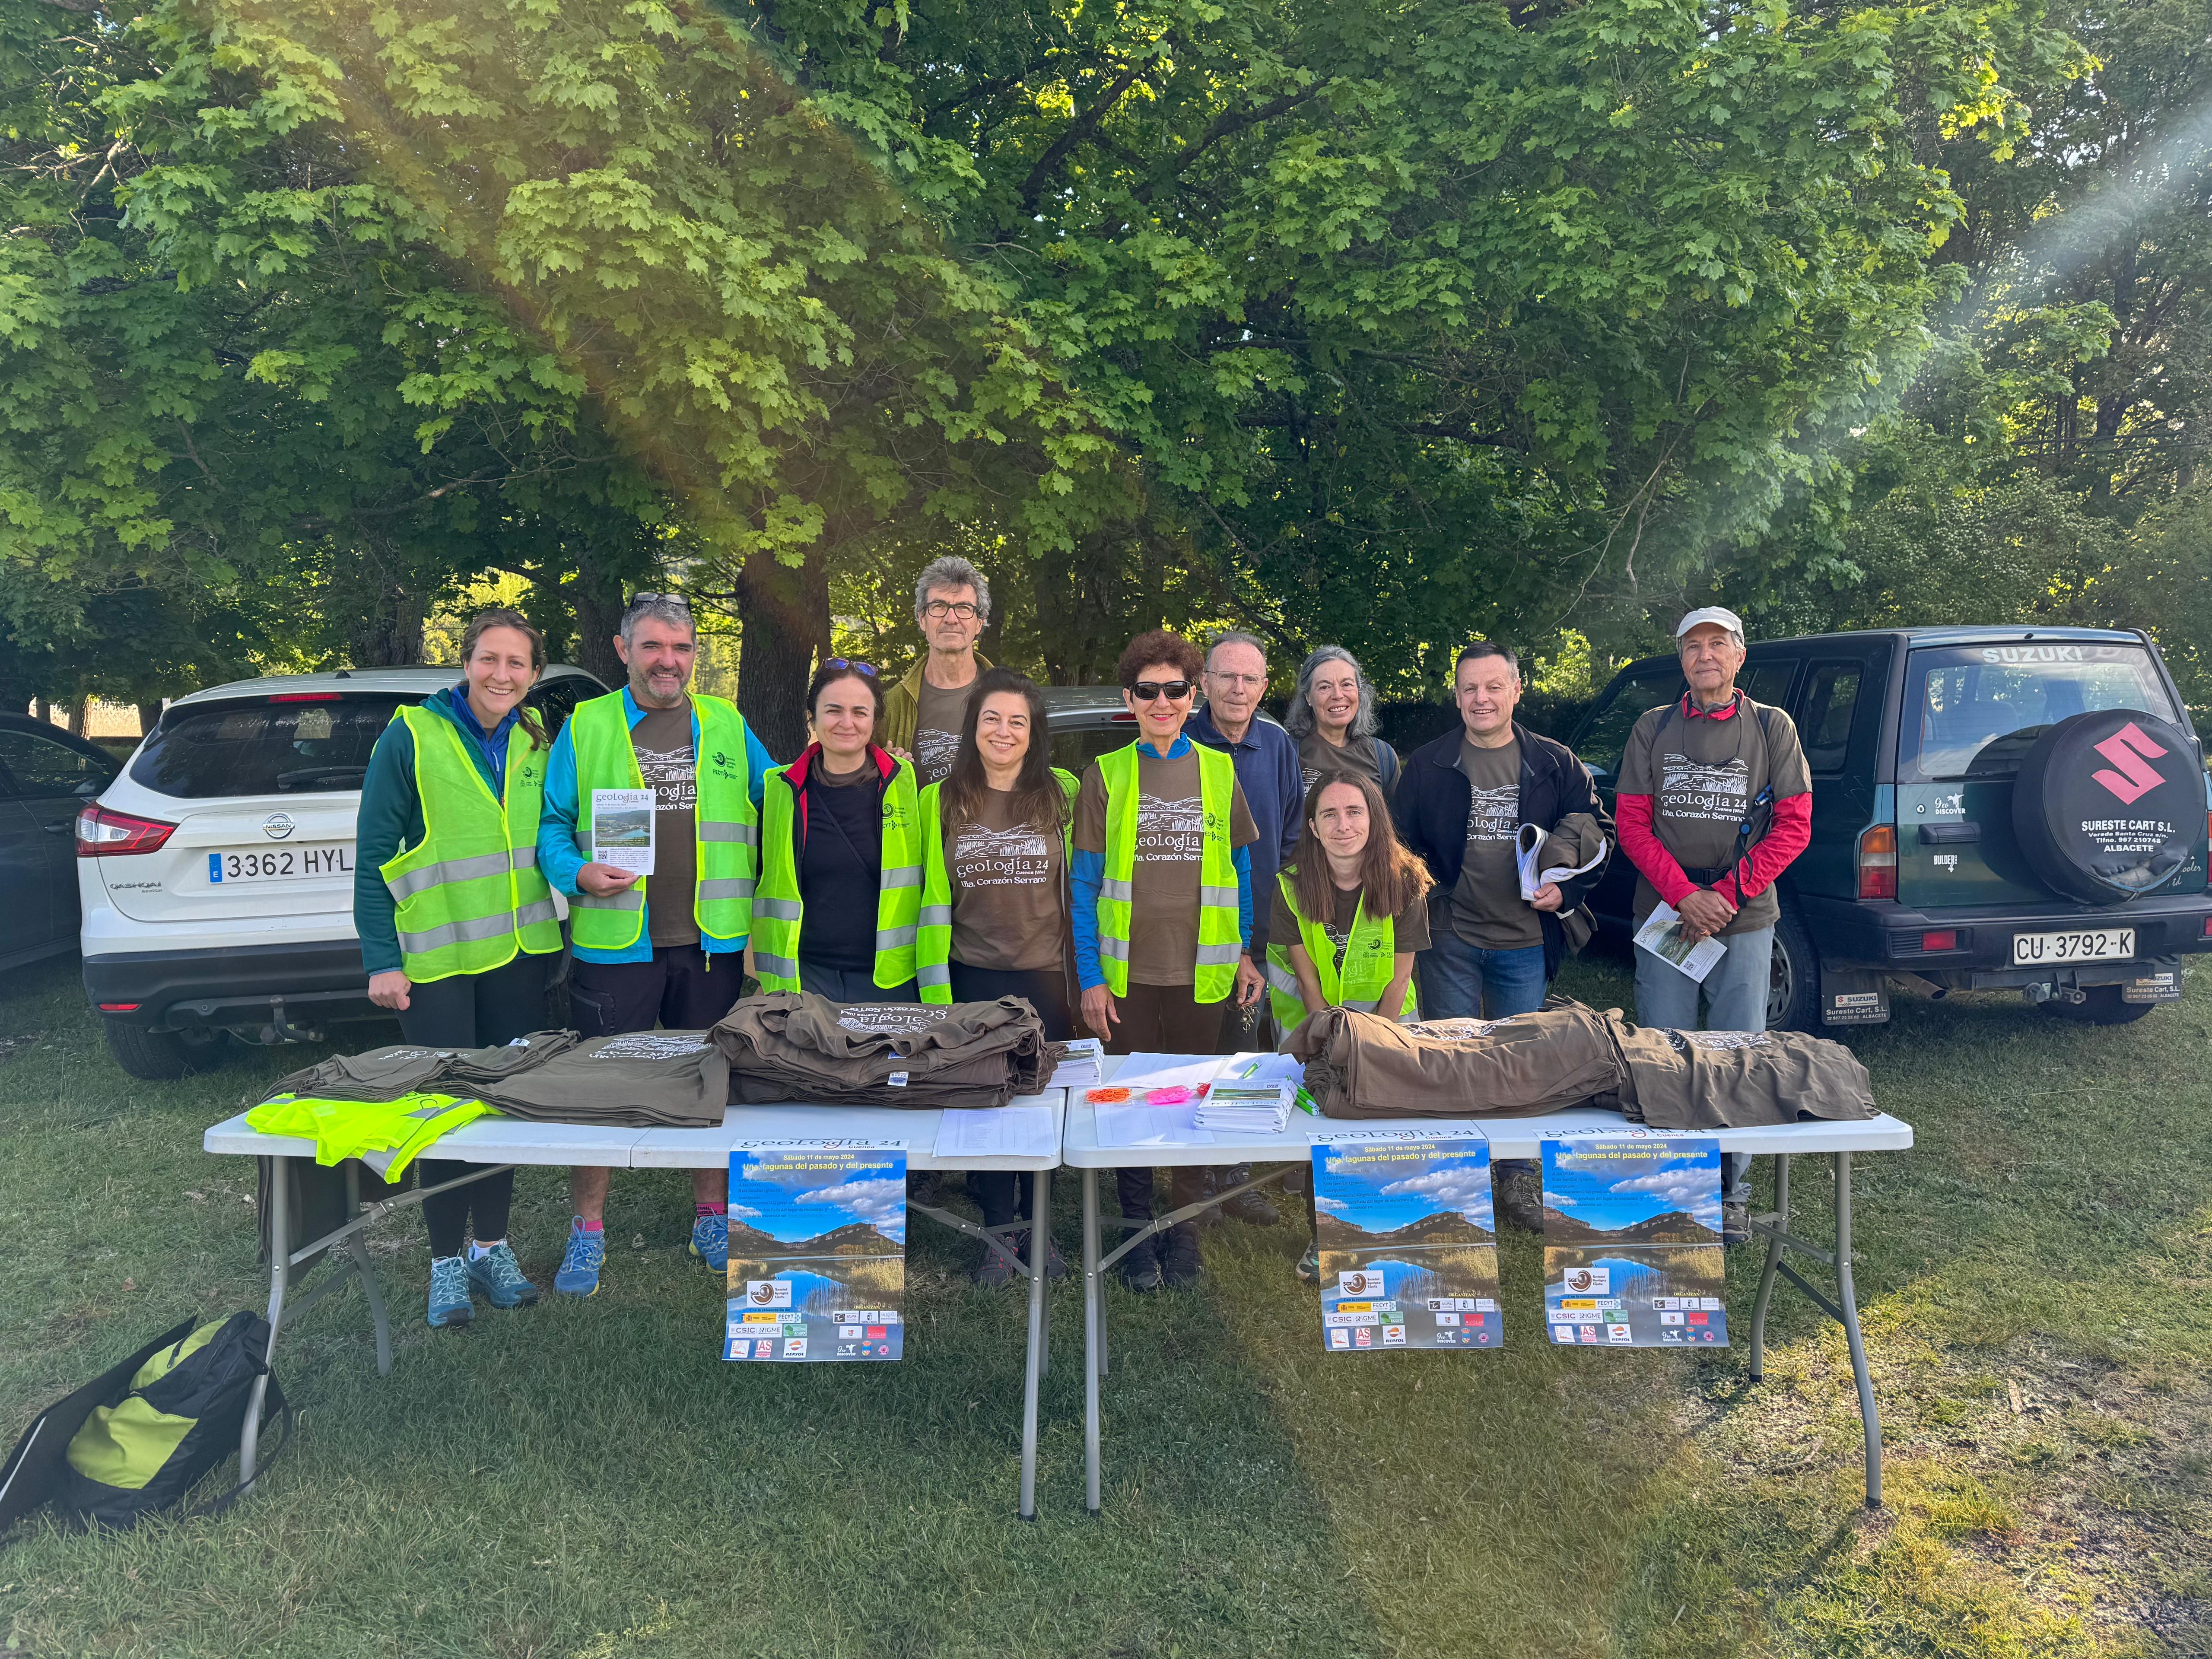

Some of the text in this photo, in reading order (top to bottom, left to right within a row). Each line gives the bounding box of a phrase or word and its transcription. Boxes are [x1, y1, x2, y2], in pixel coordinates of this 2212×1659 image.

[1982, 646, 2083, 663] SUZUKI
[1734, 799, 1747, 810] 24
[1676, 810, 1710, 819] Corazón
[2082, 820, 2176, 833] SURESTE CART S.L.
[1146, 853, 1182, 861] Corazón
[1934, 855, 1955, 865] BULDER
[227, 849, 353, 877] 3362 HYL
[1036, 859, 1049, 870] 24
[110, 881, 161, 890] QASHQAI
[977, 877, 1012, 886] Corazón
[2017, 932, 2132, 960] CU 3792 K
[1345, 1154, 1376, 1164] lagunas
[1391, 1153, 1419, 1162] pasado
[1442, 1150, 1476, 1159] presente
[1576, 1152, 1606, 1160] lagunas
[763, 1163, 793, 1171] lagunas
[809, 1162, 837, 1170] pasado
[860, 1161, 893, 1170] presente
[1355, 1328, 1370, 1338] IAS
[1580, 1326, 1595, 1336] IAS
[756, 1340, 772, 1351] IAS
